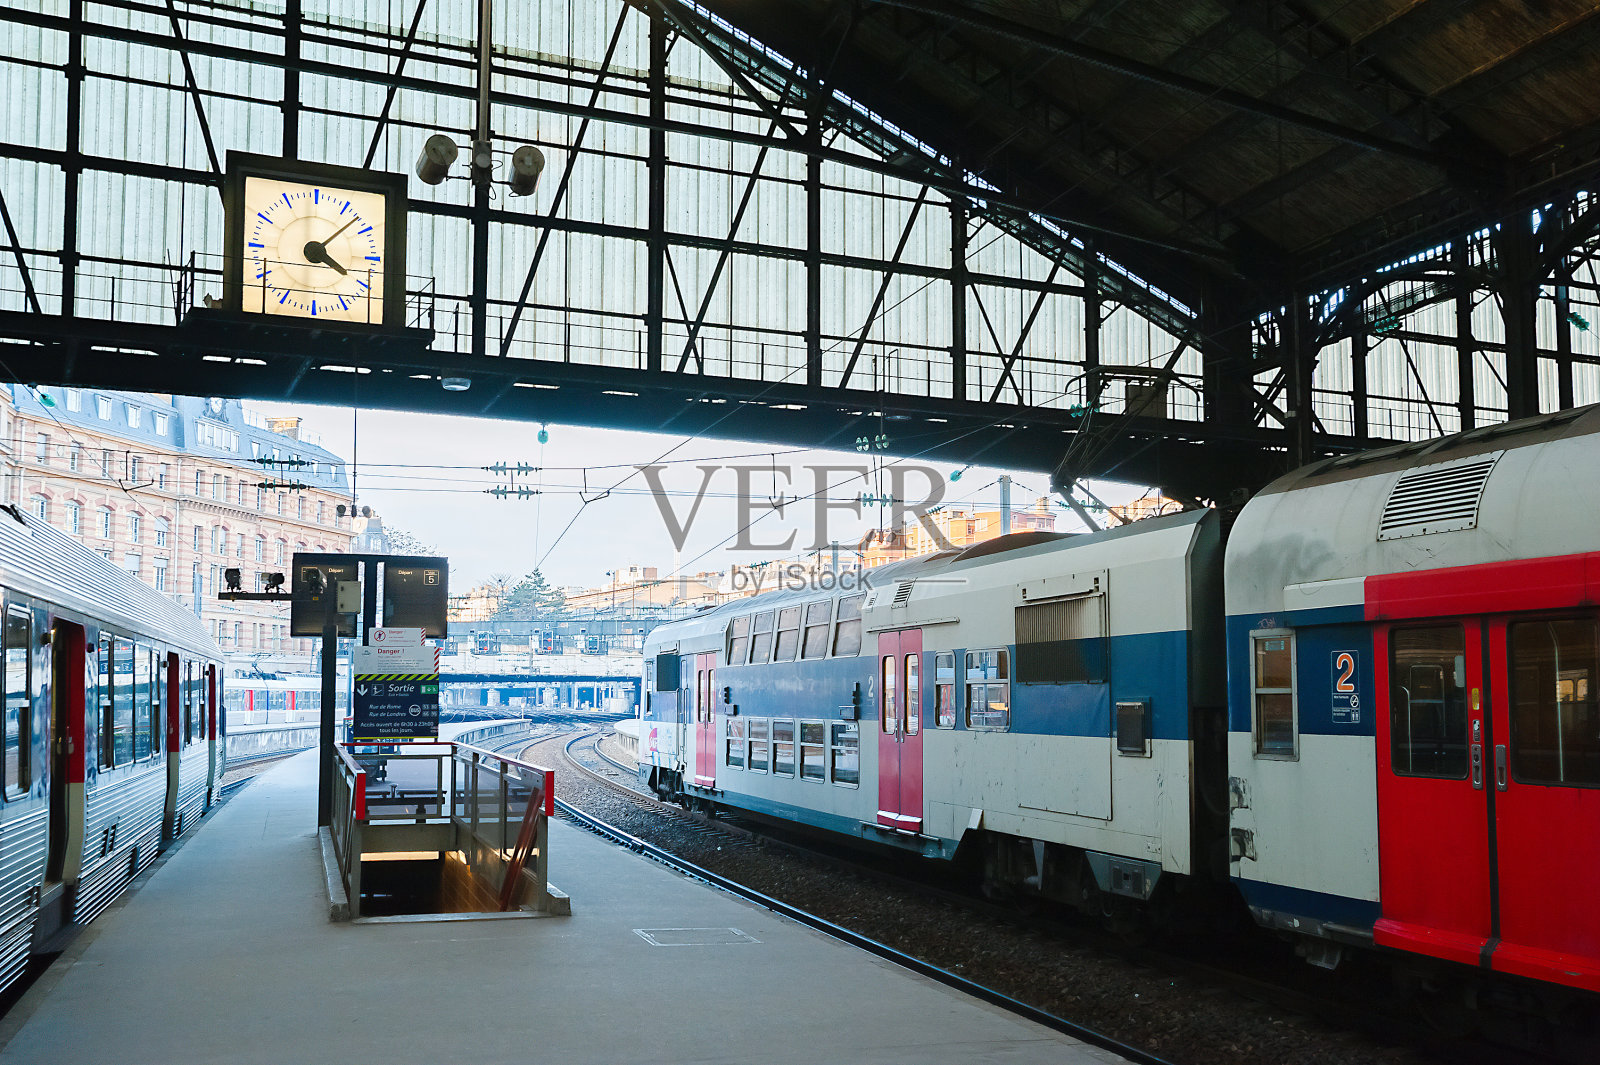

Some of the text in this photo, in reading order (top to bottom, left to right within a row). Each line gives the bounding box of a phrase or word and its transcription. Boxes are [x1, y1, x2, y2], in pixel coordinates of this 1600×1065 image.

[1336, 652, 1354, 692] 2
[388, 684, 415, 692] Sortie
[868, 676, 874, 698] 2
